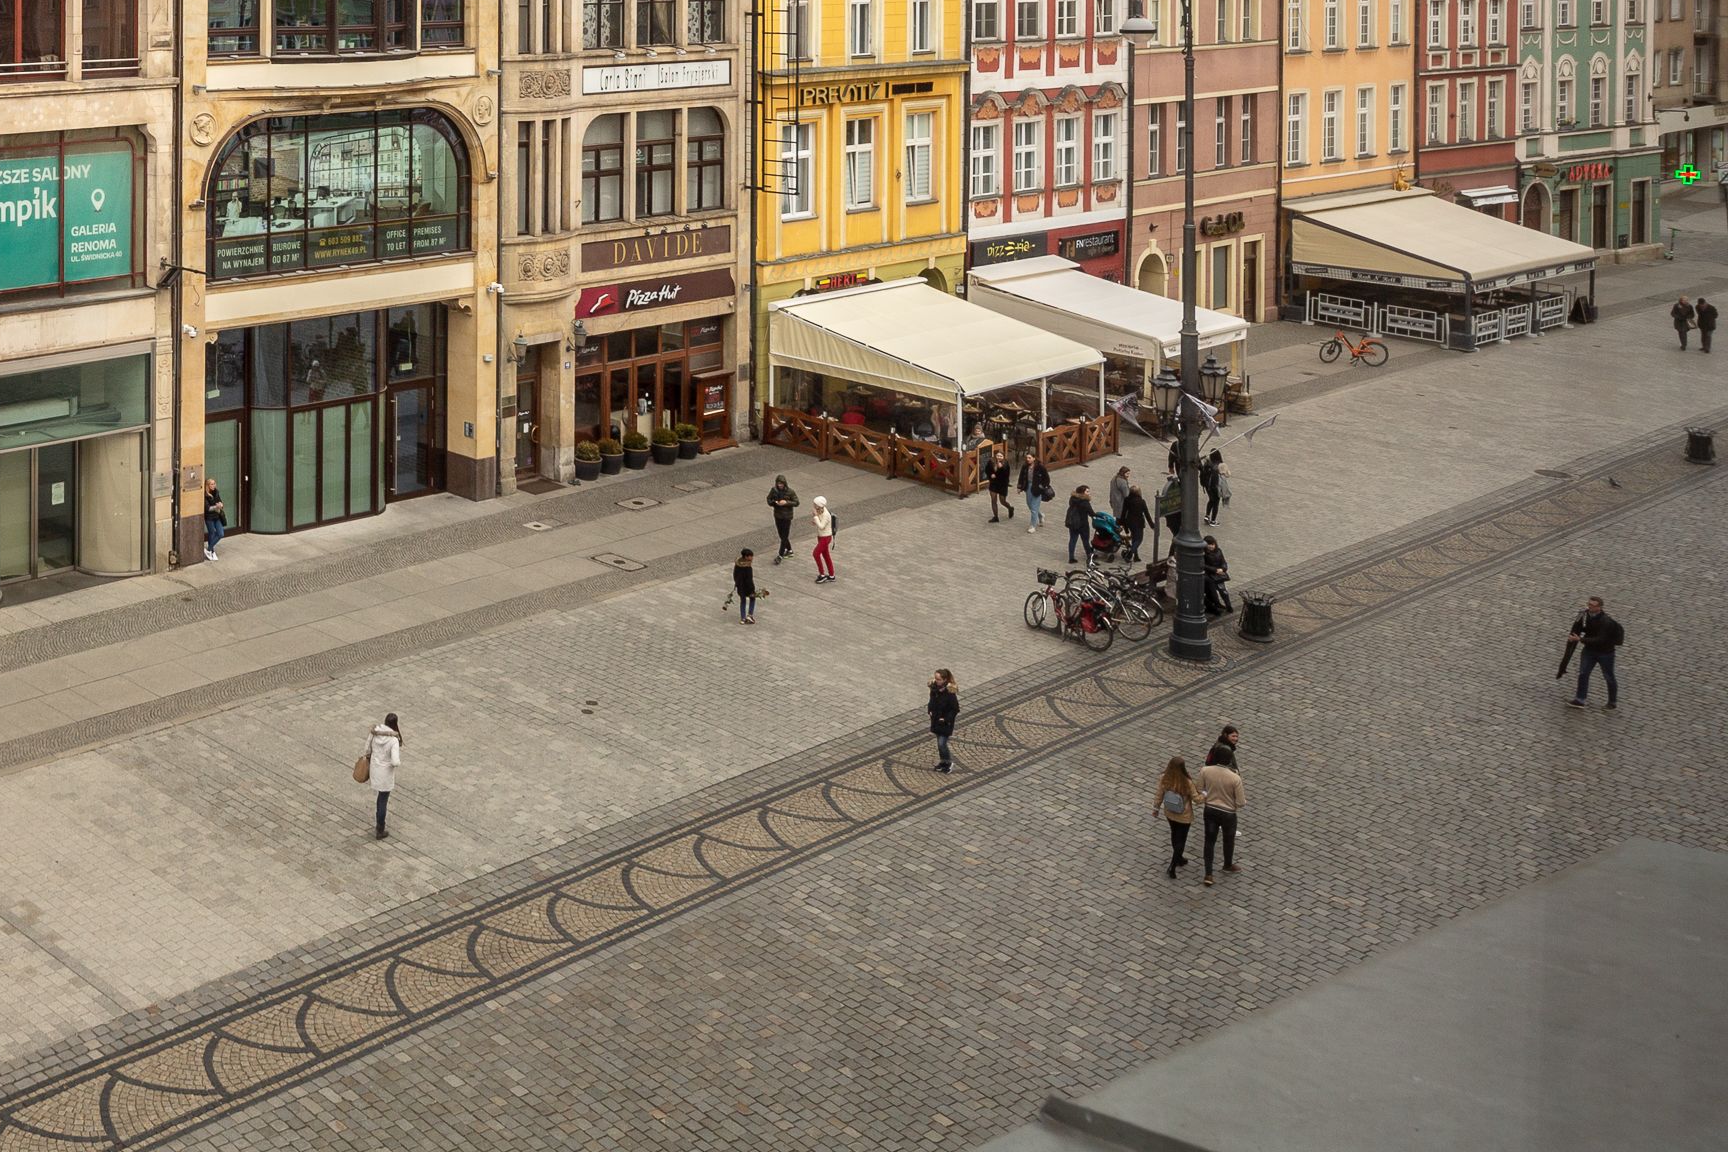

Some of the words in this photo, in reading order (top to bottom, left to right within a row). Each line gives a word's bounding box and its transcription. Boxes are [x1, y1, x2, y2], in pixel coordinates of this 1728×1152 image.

[660, 67, 678, 83] Salon
[32, 163, 91, 182] SALONY
[71, 222, 117, 237] GALERIA
[386, 229, 406, 239] OFFICE
[413, 225, 442, 236] PREMISES
[71, 238, 117, 253] RENOMA
[217, 245, 264, 258] POWIERZCHNIE
[272, 241, 301, 252] BIUROWE
[387, 242, 395, 251] TO
[396, 241, 406, 250] LET
[413, 238, 429, 248] FROM
[613, 232, 702, 265] DAVIDE
[222, 261, 232, 270] NA
[233, 257, 264, 268] WYNAJEM
[283, 254, 290, 263] 87
[625, 289, 658, 309] Pizza
[658, 284, 683, 302] Hut
